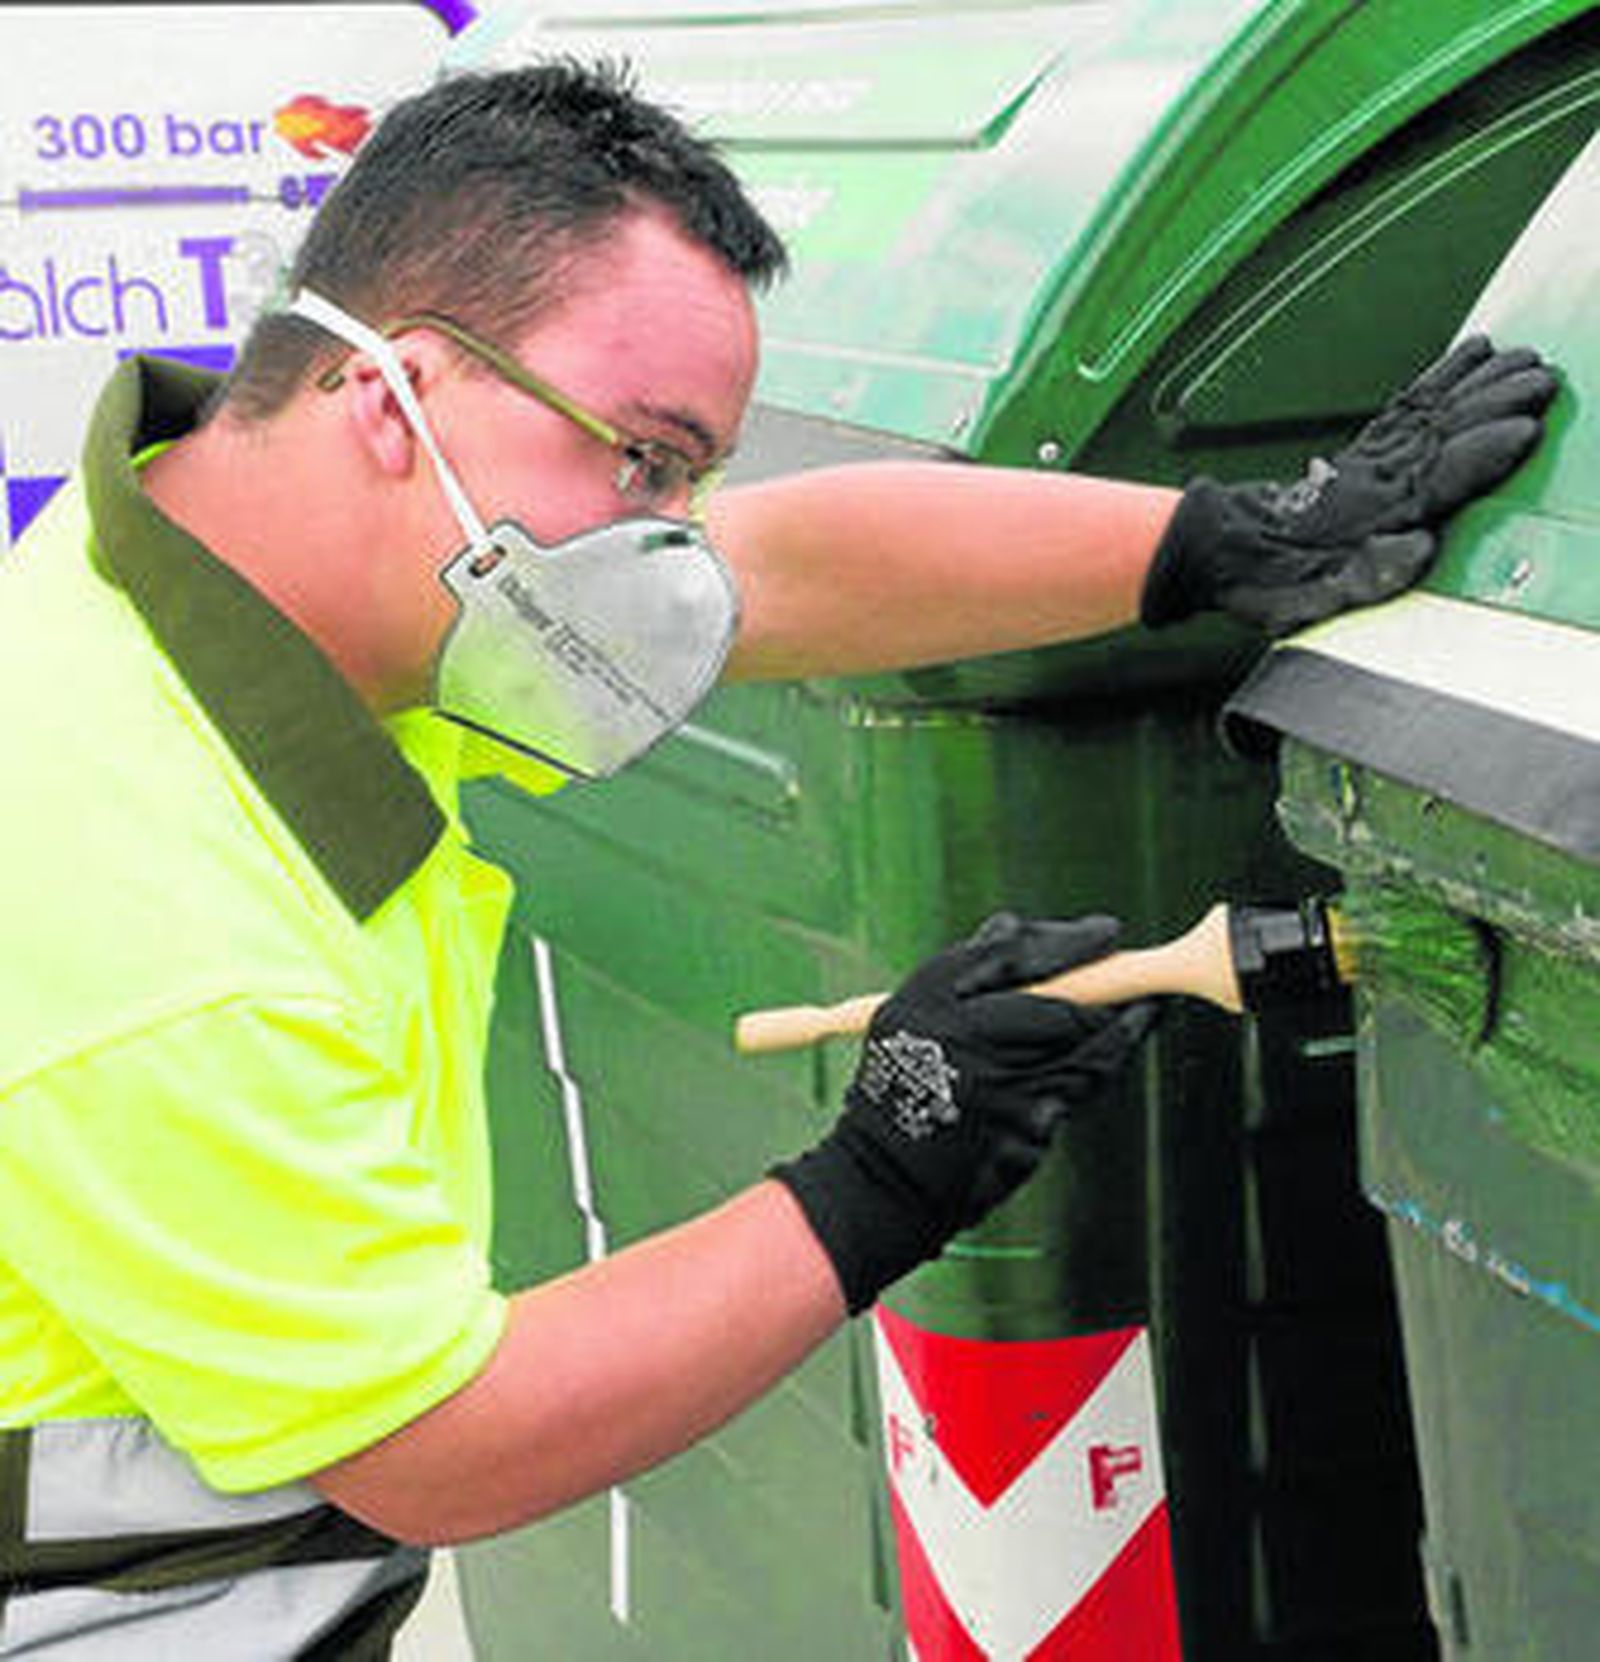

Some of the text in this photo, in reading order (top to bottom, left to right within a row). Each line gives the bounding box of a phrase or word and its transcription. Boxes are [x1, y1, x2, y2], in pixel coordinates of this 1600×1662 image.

[34, 113, 265, 160] 300 bar
[0, 252, 167, 341] alch
[1088, 1445, 1142, 1511] F
